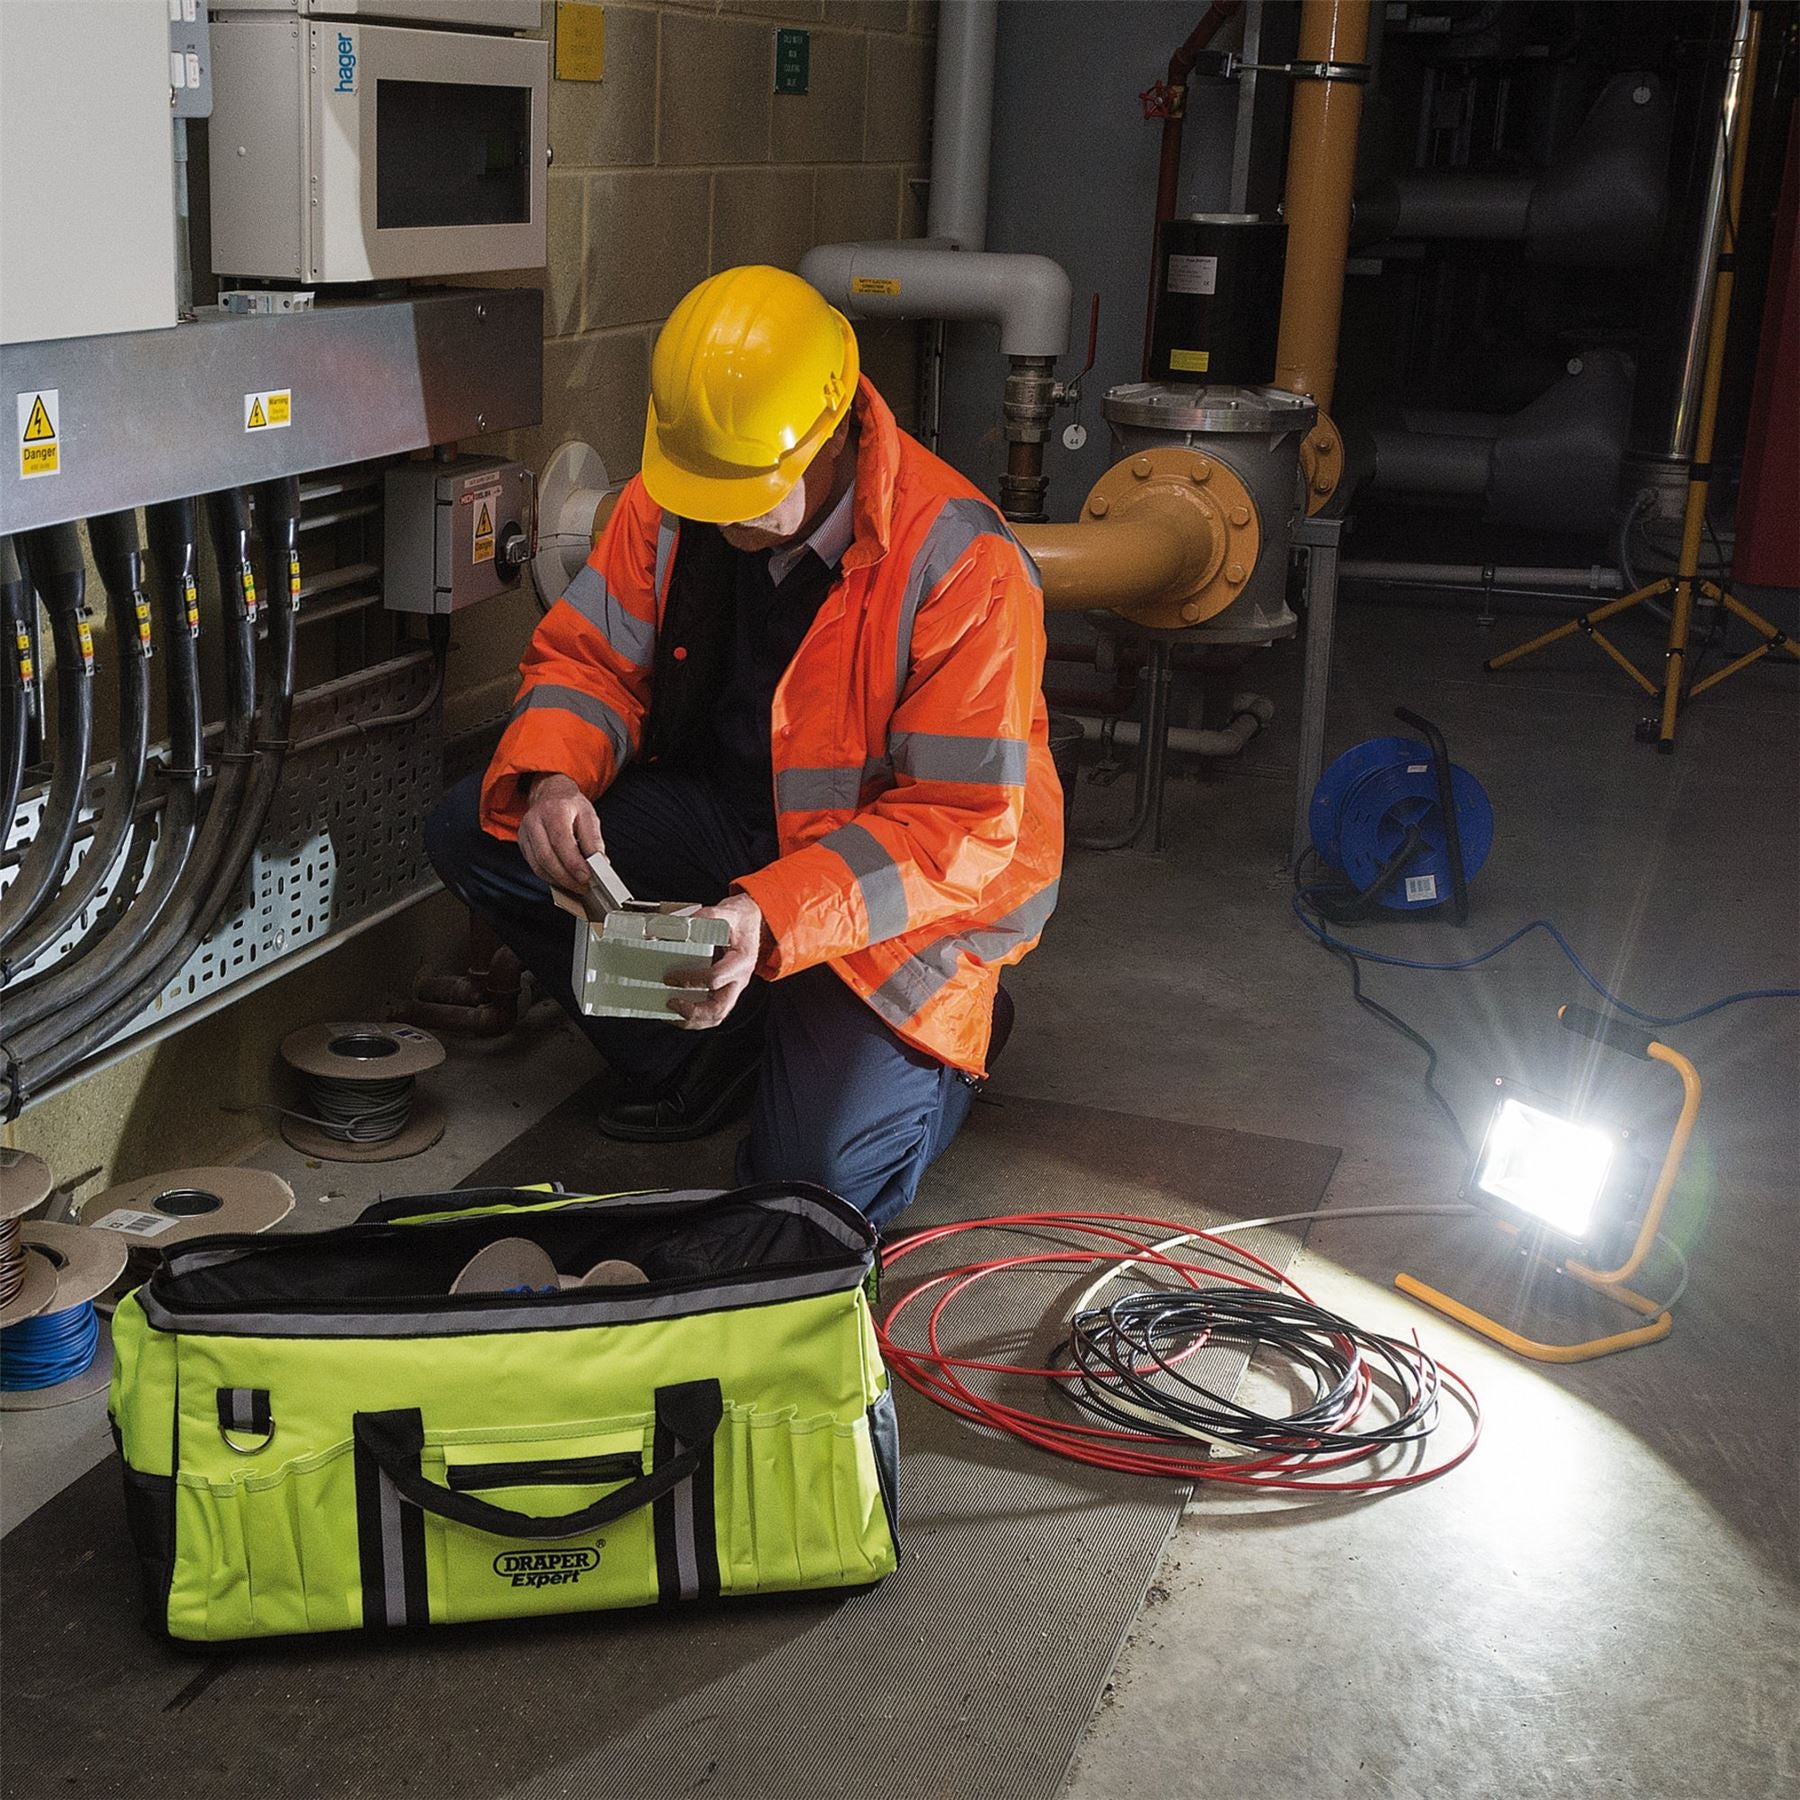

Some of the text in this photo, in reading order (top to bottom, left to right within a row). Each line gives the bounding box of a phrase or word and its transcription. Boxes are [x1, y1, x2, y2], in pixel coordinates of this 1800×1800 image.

[334, 32, 356, 92] hager
[24, 447, 56, 460] Danger
[504, 1553, 590, 1572] DRAPER
[511, 1570, 580, 1588] Expert
